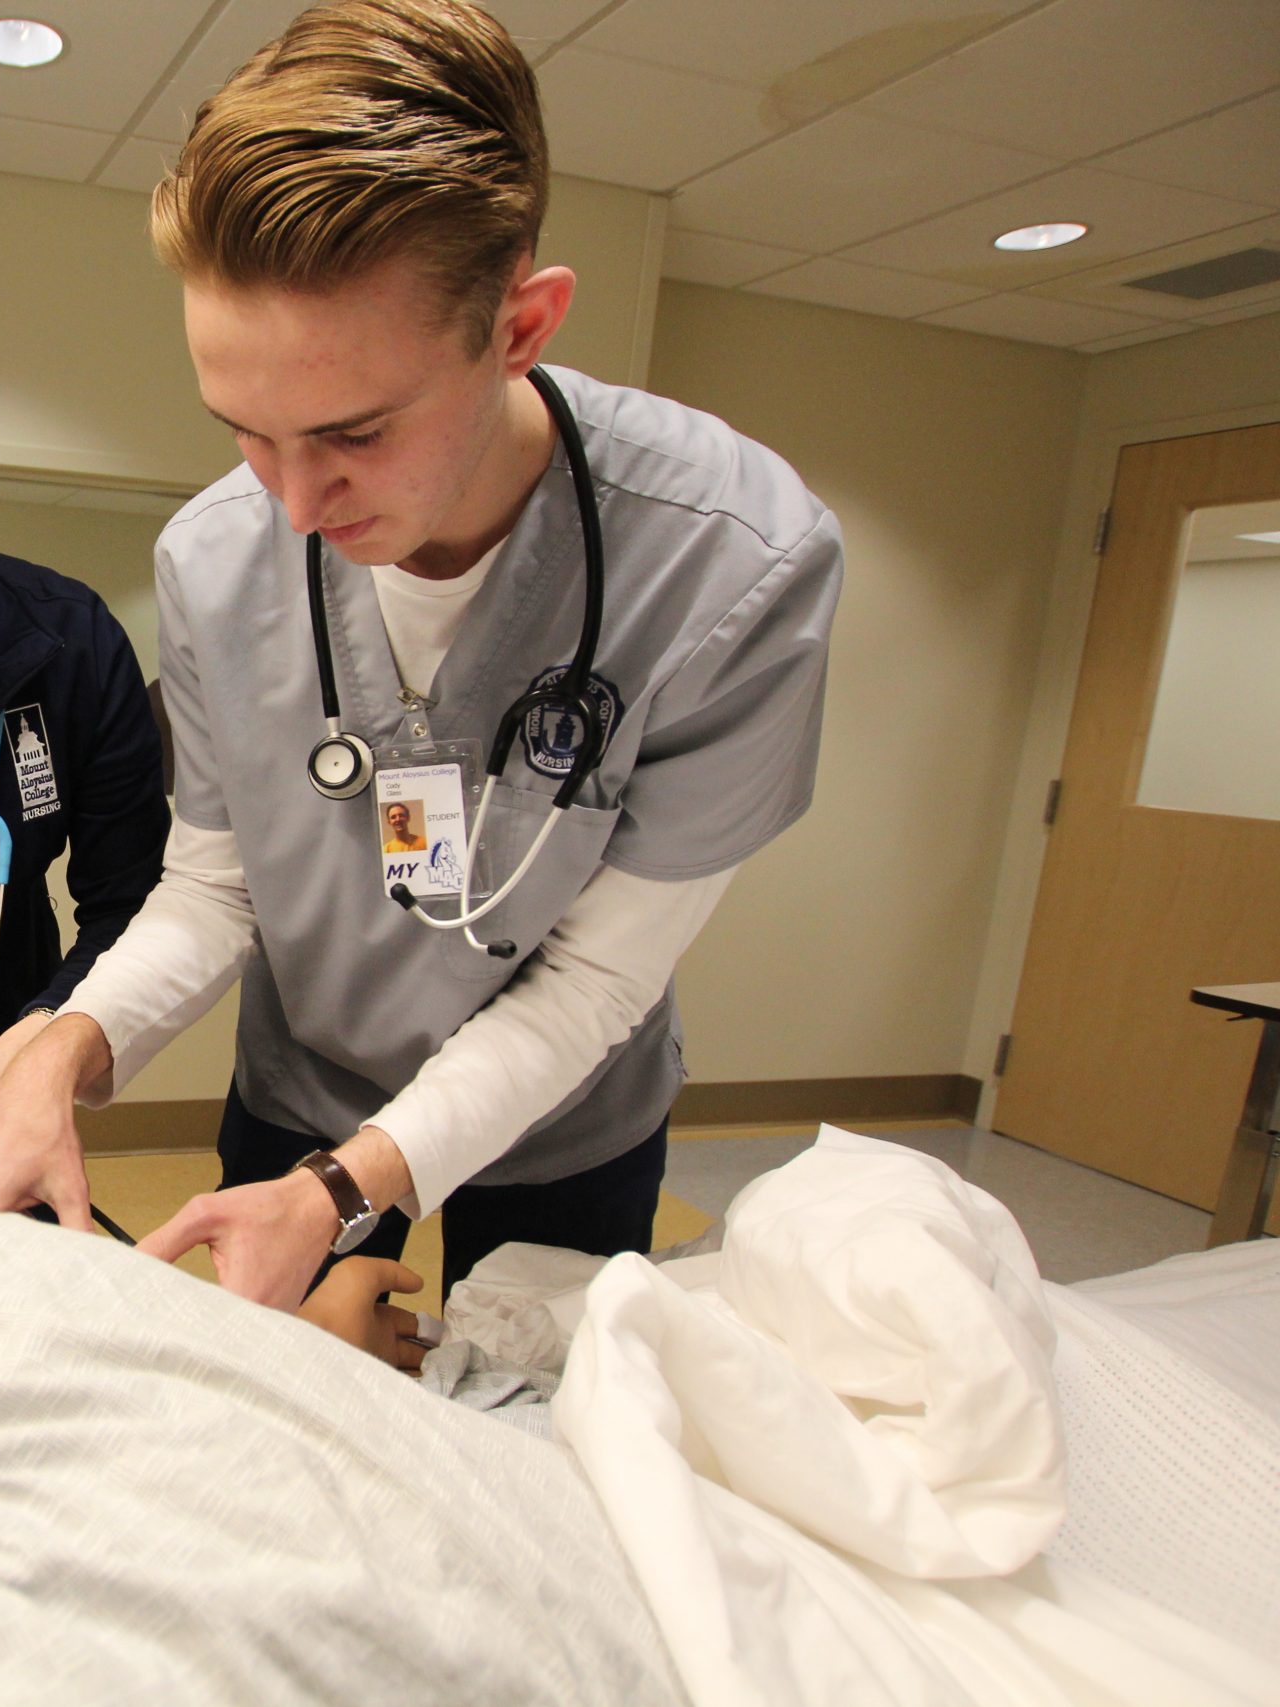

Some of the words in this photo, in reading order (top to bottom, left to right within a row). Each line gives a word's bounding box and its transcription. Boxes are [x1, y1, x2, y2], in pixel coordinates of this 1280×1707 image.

[530, 705, 542, 737] MOUN
[20, 760, 49, 776] Mount
[535, 751, 576, 768] NURSIN
[21, 773, 54, 790] Aloysius
[379, 772, 401, 781] Mount
[402, 770, 430, 779] Aloysius
[431, 767, 458, 776] College
[24, 786, 55, 801] College
[22, 801, 61, 822] NURSING
[426, 812, 461, 822] STUDENT
[386, 862, 419, 880] MY
